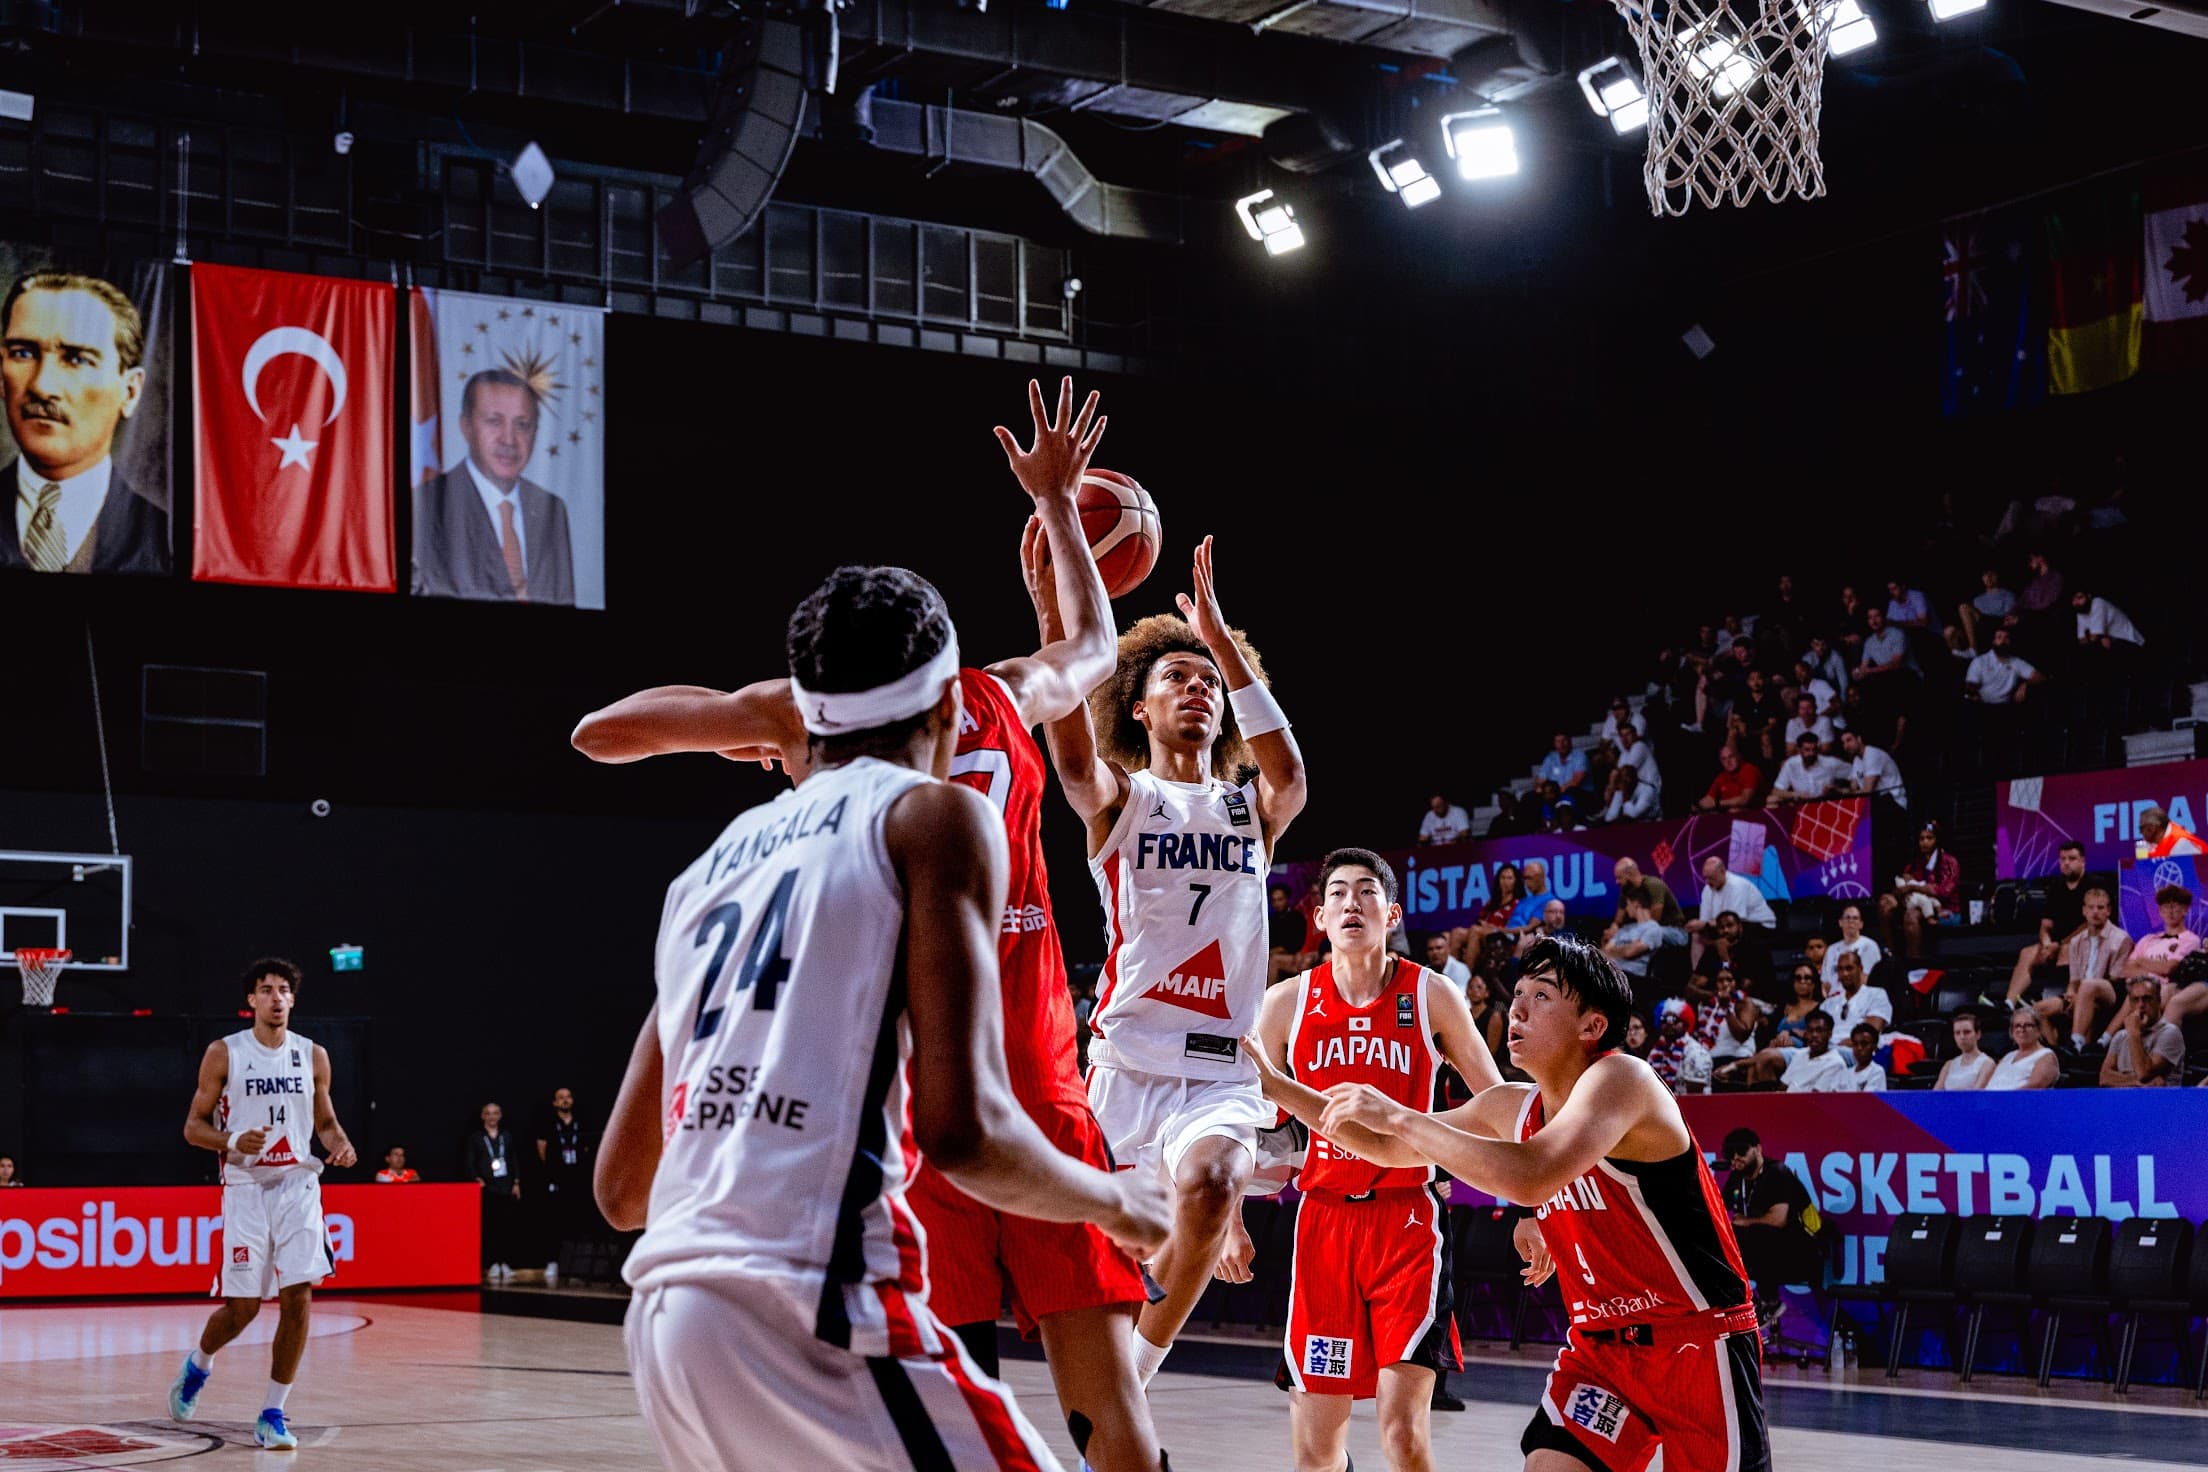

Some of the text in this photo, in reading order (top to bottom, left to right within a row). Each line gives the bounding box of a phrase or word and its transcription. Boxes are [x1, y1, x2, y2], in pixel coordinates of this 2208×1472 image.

[705, 795, 849, 886] YANGALA
[1136, 832, 1257, 875] FRANCE
[1188, 883, 1211, 926] 7
[1407, 851, 1607, 915] İSTAUL
[693, 868, 800, 1042] 24
[1157, 973, 1226, 1000] MAIF
[1399, 1012, 1413, 1020] FIBA
[1308, 1036, 1411, 1076] JAPAN
[245, 1077, 304, 1096] FRANCE
[269, 1105, 286, 1125] 14
[1784, 1151, 2180, 1222] ASKETBALL
[0, 1200, 355, 1285] psibura
[1586, 1289, 1665, 1319] SftBank
